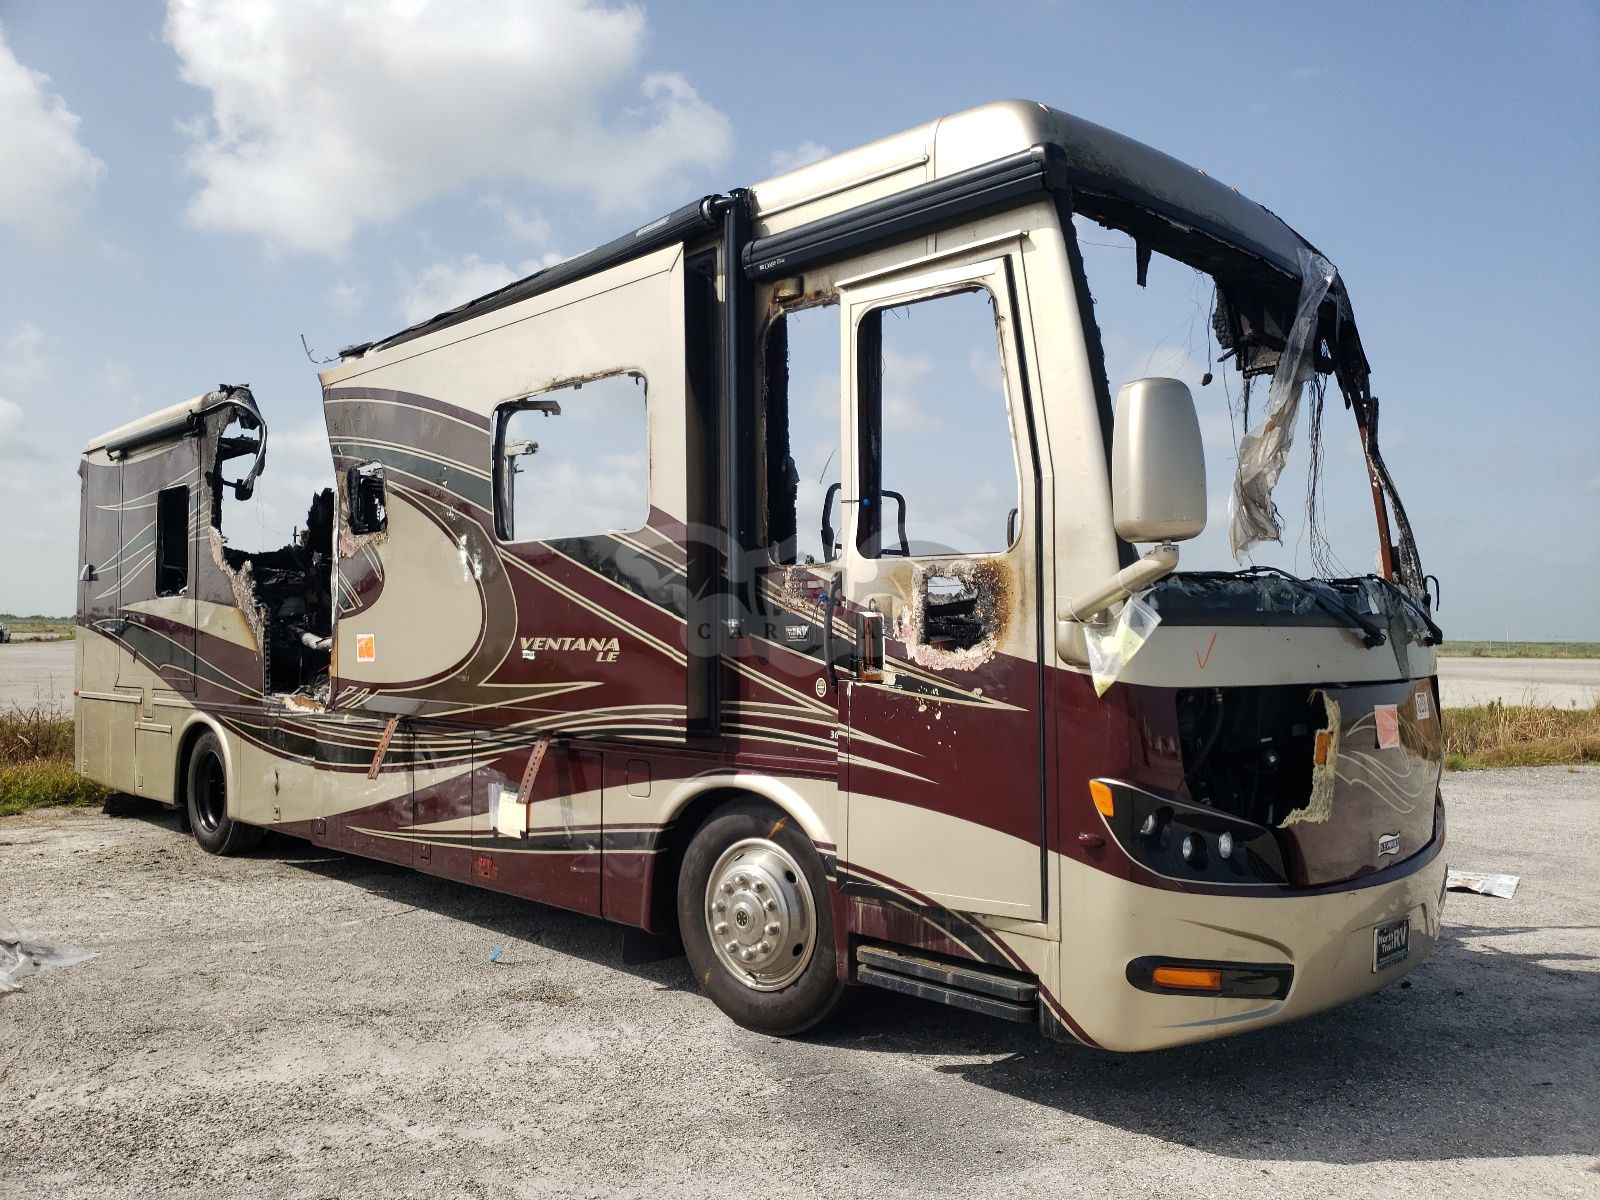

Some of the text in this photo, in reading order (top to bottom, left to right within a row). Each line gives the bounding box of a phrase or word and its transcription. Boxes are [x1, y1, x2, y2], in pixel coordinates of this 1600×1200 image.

[520, 637, 620, 652] VENTANA
[596, 651, 620, 662] LE
[1378, 931, 1394, 946] North
[1393, 926, 1408, 949] RV
